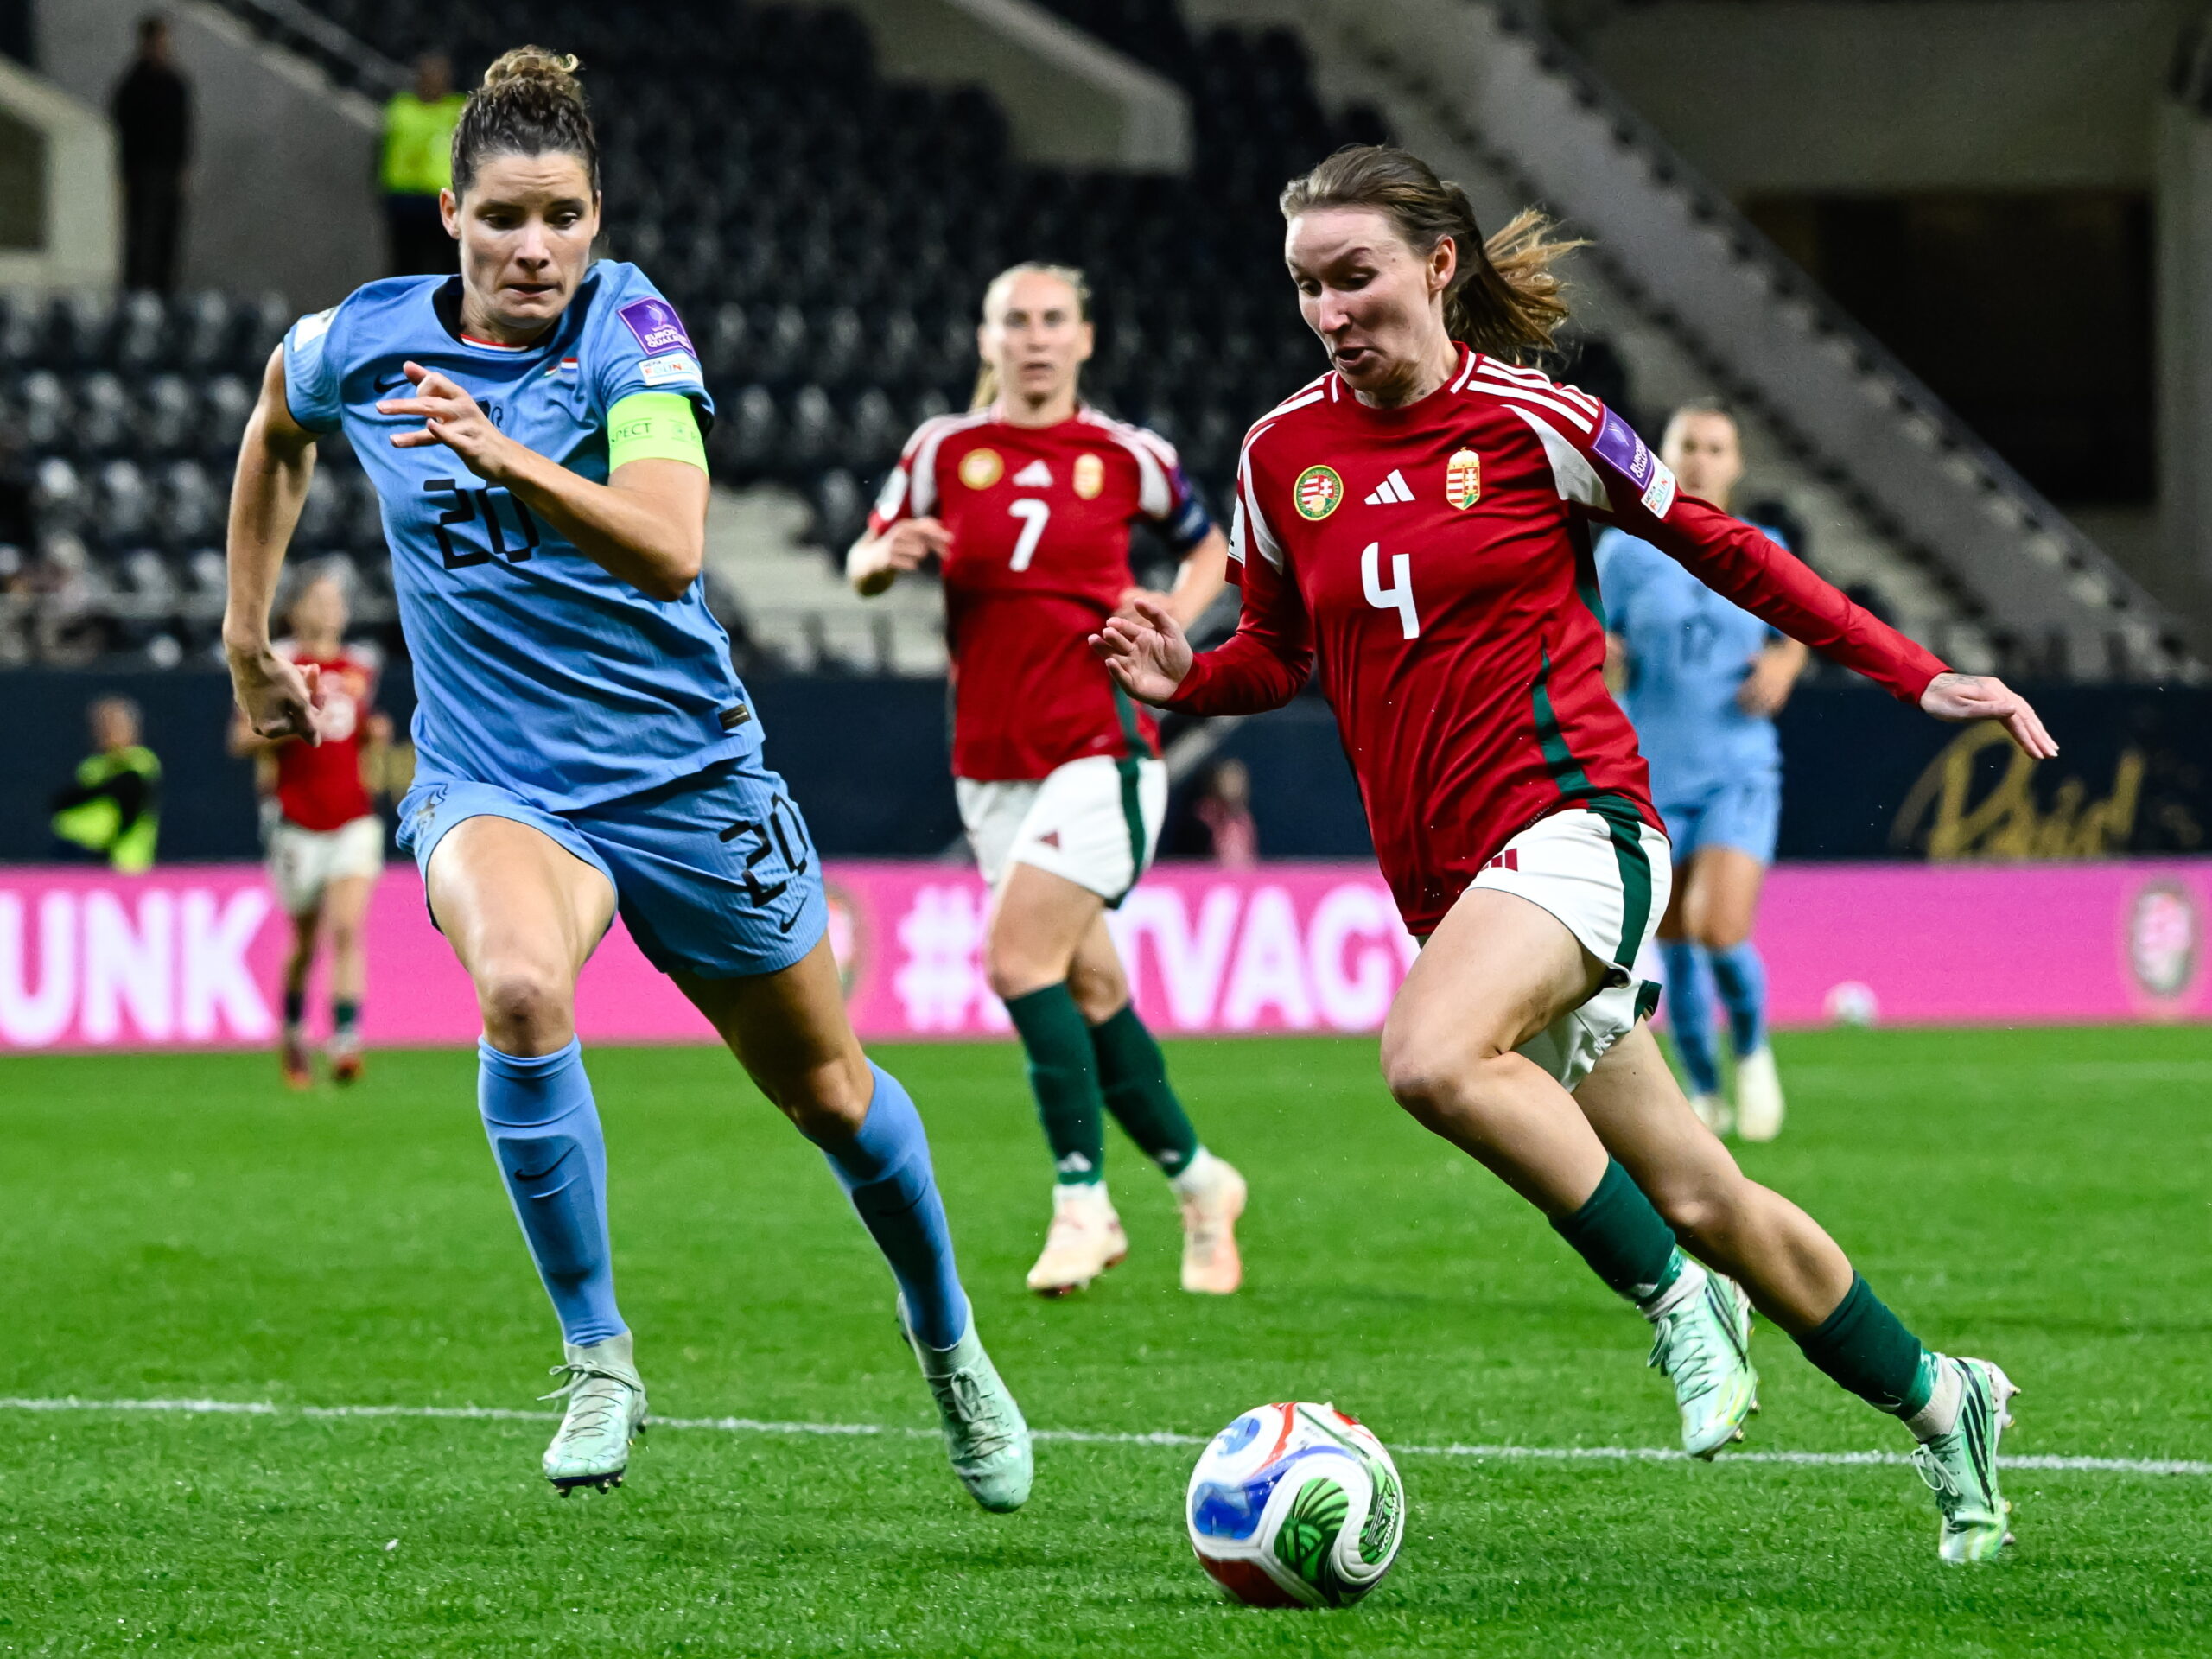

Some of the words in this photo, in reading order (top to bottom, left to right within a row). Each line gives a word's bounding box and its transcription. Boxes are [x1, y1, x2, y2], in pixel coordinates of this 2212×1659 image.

[423, 478, 540, 570] 20
[1008, 499, 1050, 571] 7
[1360, 542, 1421, 640] 4
[719, 792, 809, 908] 20
